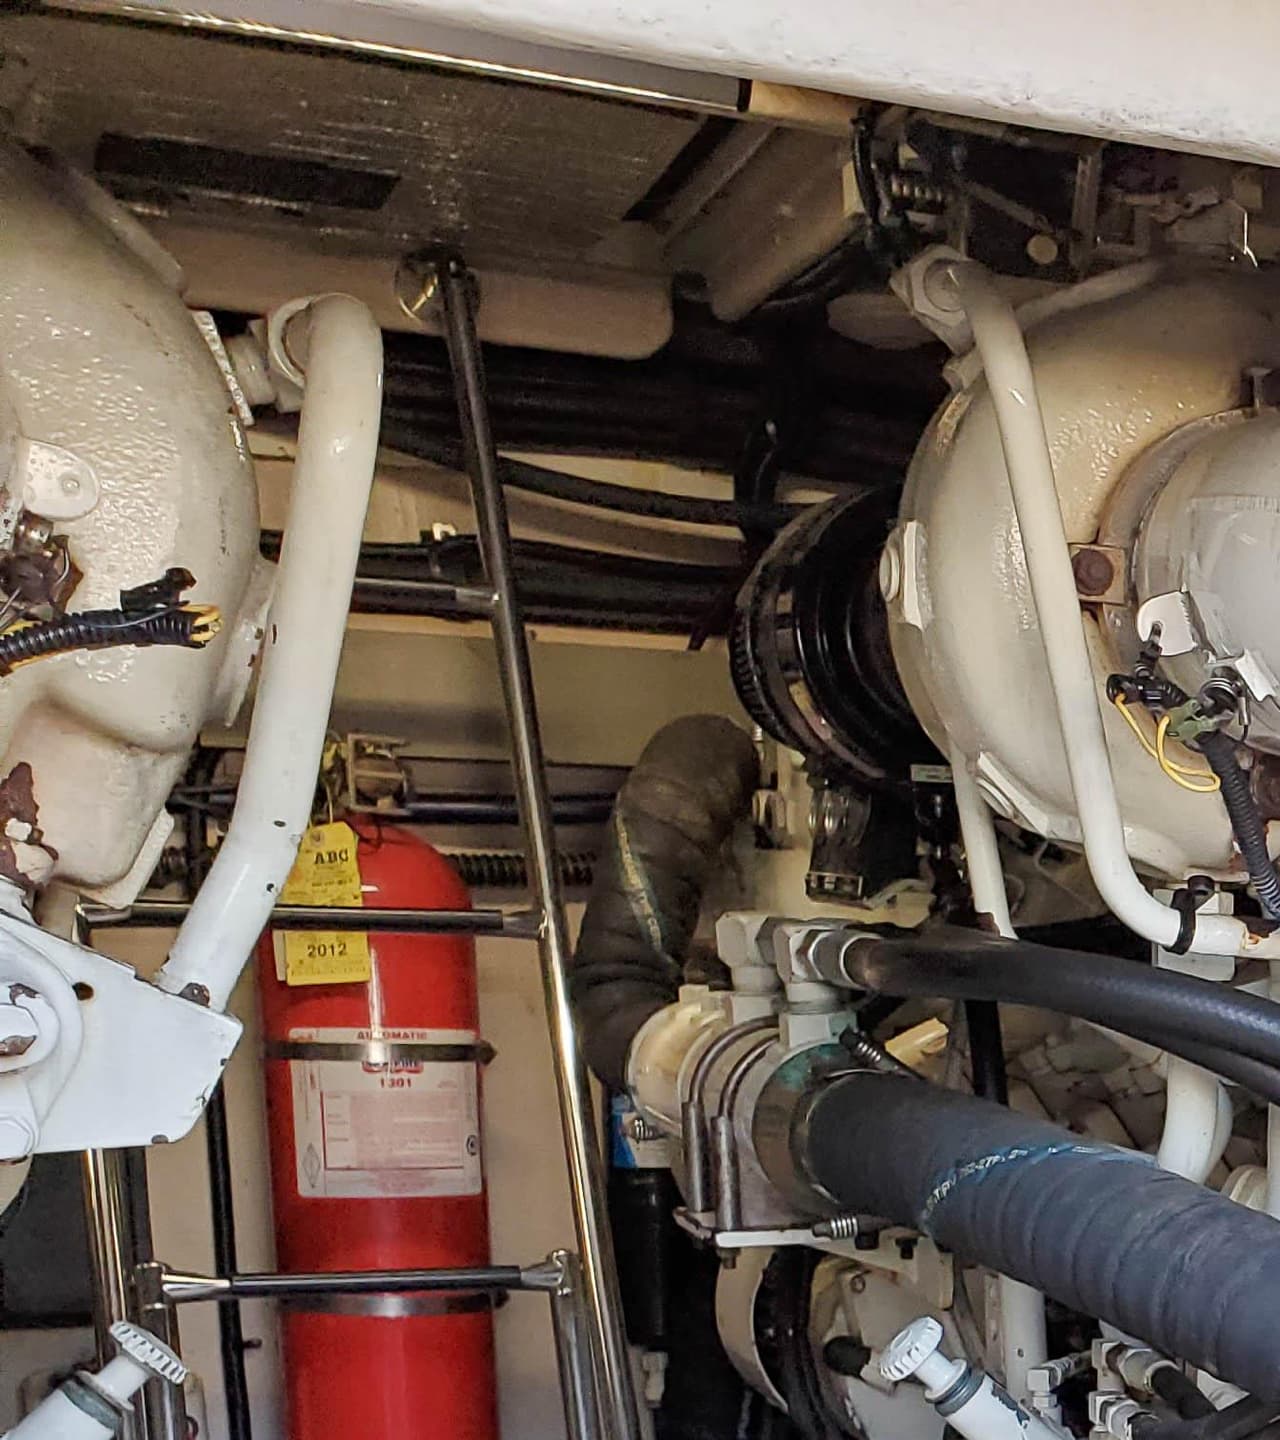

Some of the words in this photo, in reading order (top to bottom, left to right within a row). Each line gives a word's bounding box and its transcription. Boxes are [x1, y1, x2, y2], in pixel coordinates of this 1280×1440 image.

[314, 847, 350, 865] ABC
[307, 943, 348, 959] 2012
[356, 1031, 428, 1041] AUOMATIC
